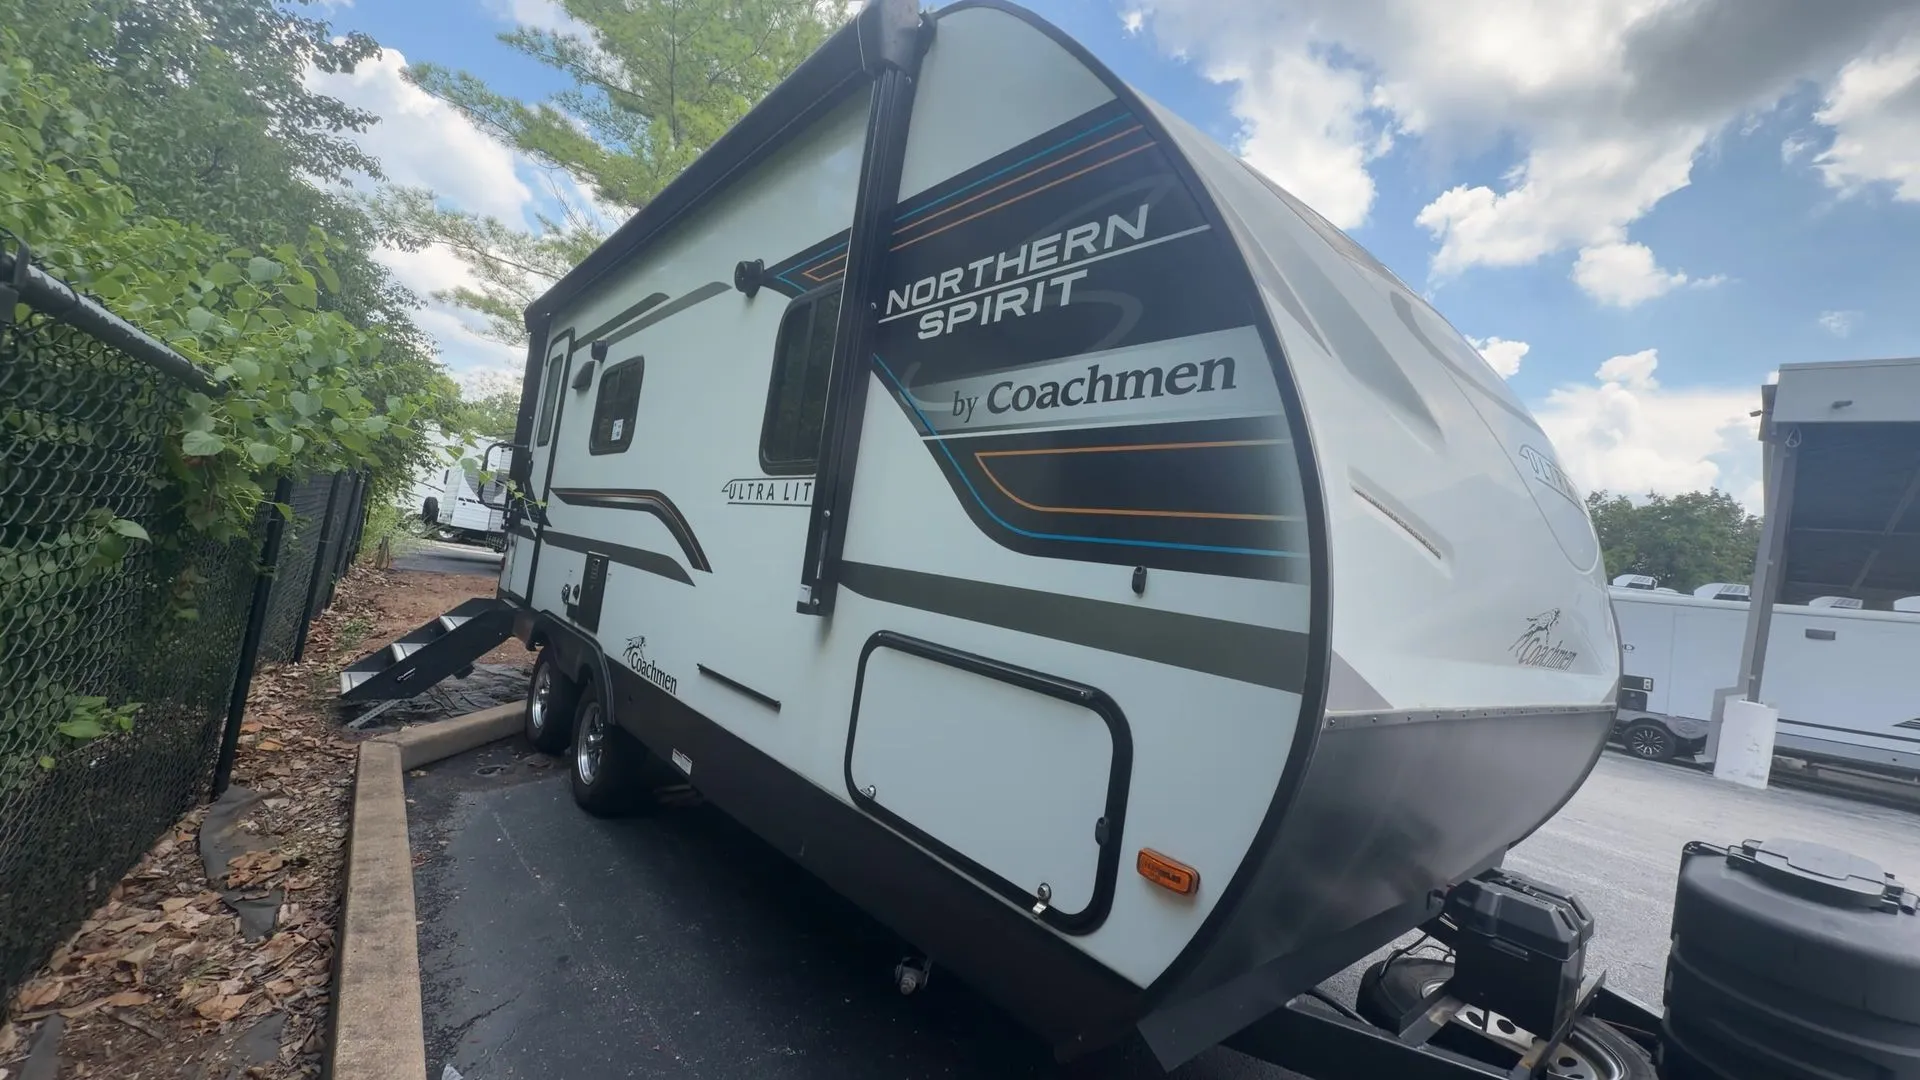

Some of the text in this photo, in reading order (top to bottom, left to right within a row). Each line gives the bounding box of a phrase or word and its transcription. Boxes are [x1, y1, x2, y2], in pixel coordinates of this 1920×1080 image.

[886, 203, 1149, 315] NORTHERN
[918, 269, 1088, 340] SPIRIT
[952, 355, 1236, 423] by Coachmen
[729, 482, 812, 501] ULTRA LIT
[631, 652, 677, 695] Coachmen
